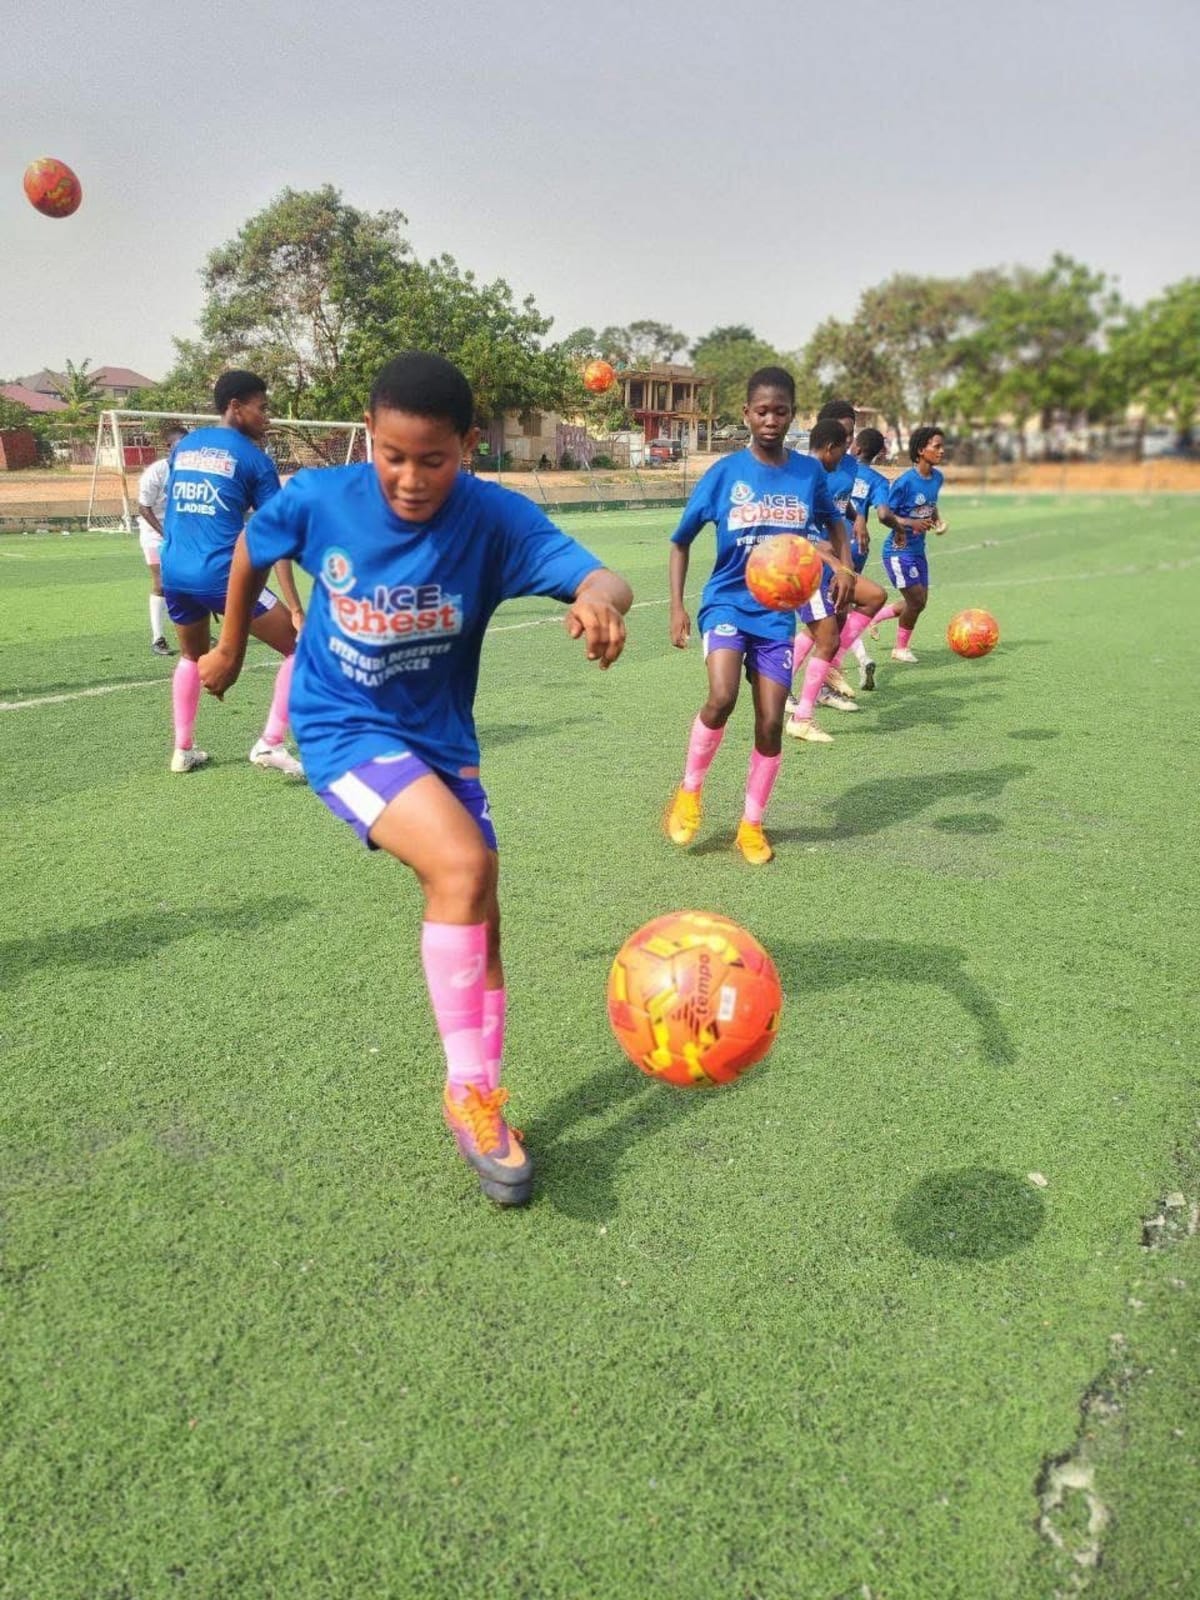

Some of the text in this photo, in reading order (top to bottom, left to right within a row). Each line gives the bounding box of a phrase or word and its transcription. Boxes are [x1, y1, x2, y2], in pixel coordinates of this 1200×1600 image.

[176, 502, 216, 516] LADIES
[763, 494, 798, 508] ICE
[375, 585, 441, 611] ICE
[331, 592, 456, 634] Chest
[696, 953, 712, 1015] tempo
